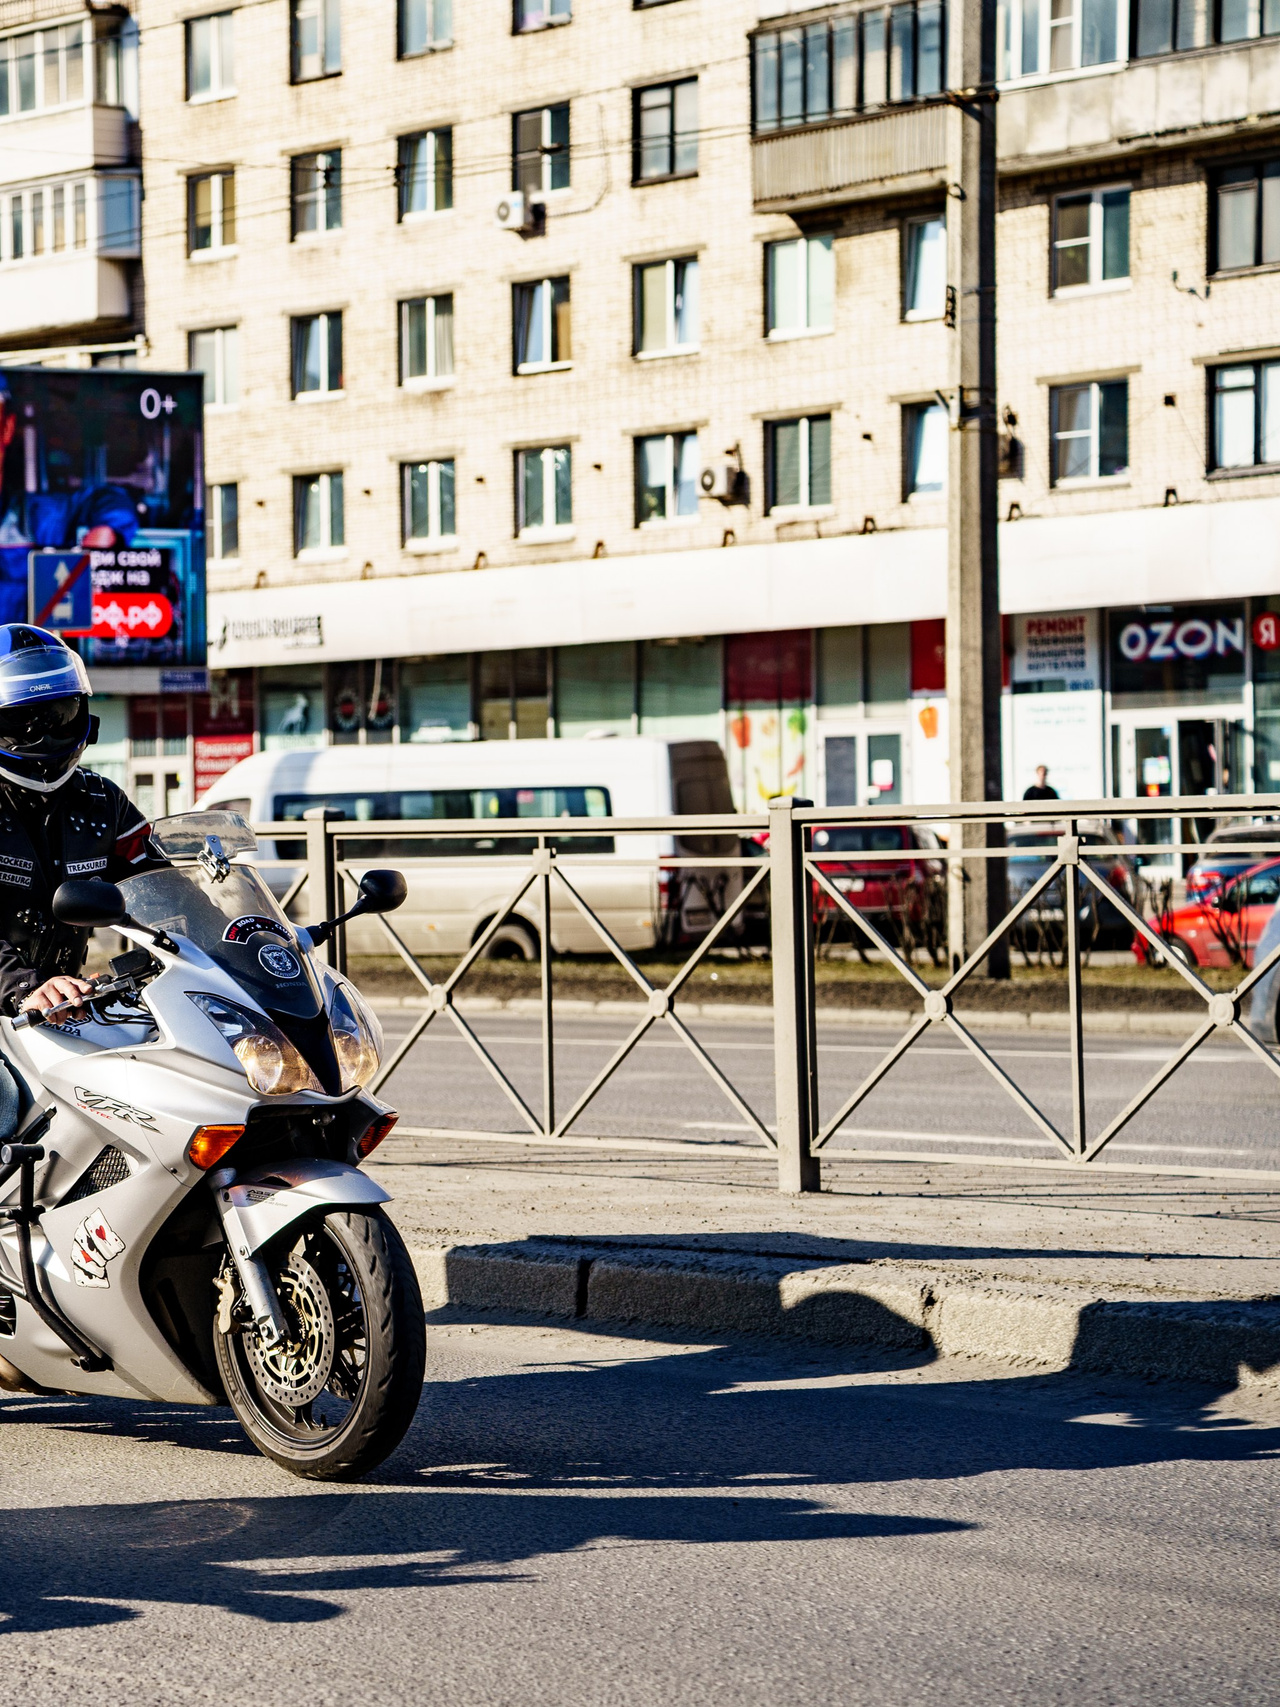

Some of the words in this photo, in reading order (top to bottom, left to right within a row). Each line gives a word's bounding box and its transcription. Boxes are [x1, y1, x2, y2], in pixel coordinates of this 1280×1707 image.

[140, 388, 178, 419] 0+
[117, 548, 161, 567] свой
[126, 570, 150, 586] на
[1026, 616, 1086, 636] РЕМОНТ
[1259, 617, 1276, 645] Я
[1119, 617, 1245, 660] OZON
[0, 854, 33, 870] ROCKERS
[67, 859, 107, 873] TREASURER
[228, 926, 239, 939] ONE
[236, 918, 255, 927] ROAD
[274, 923, 294, 940] CLUB
[275, 981, 308, 989] HONDA
[40, 1021, 81, 1037] ONDA
[74, 1086, 163, 1135] VFR
[90, 1108, 113, 1120] VTEC
